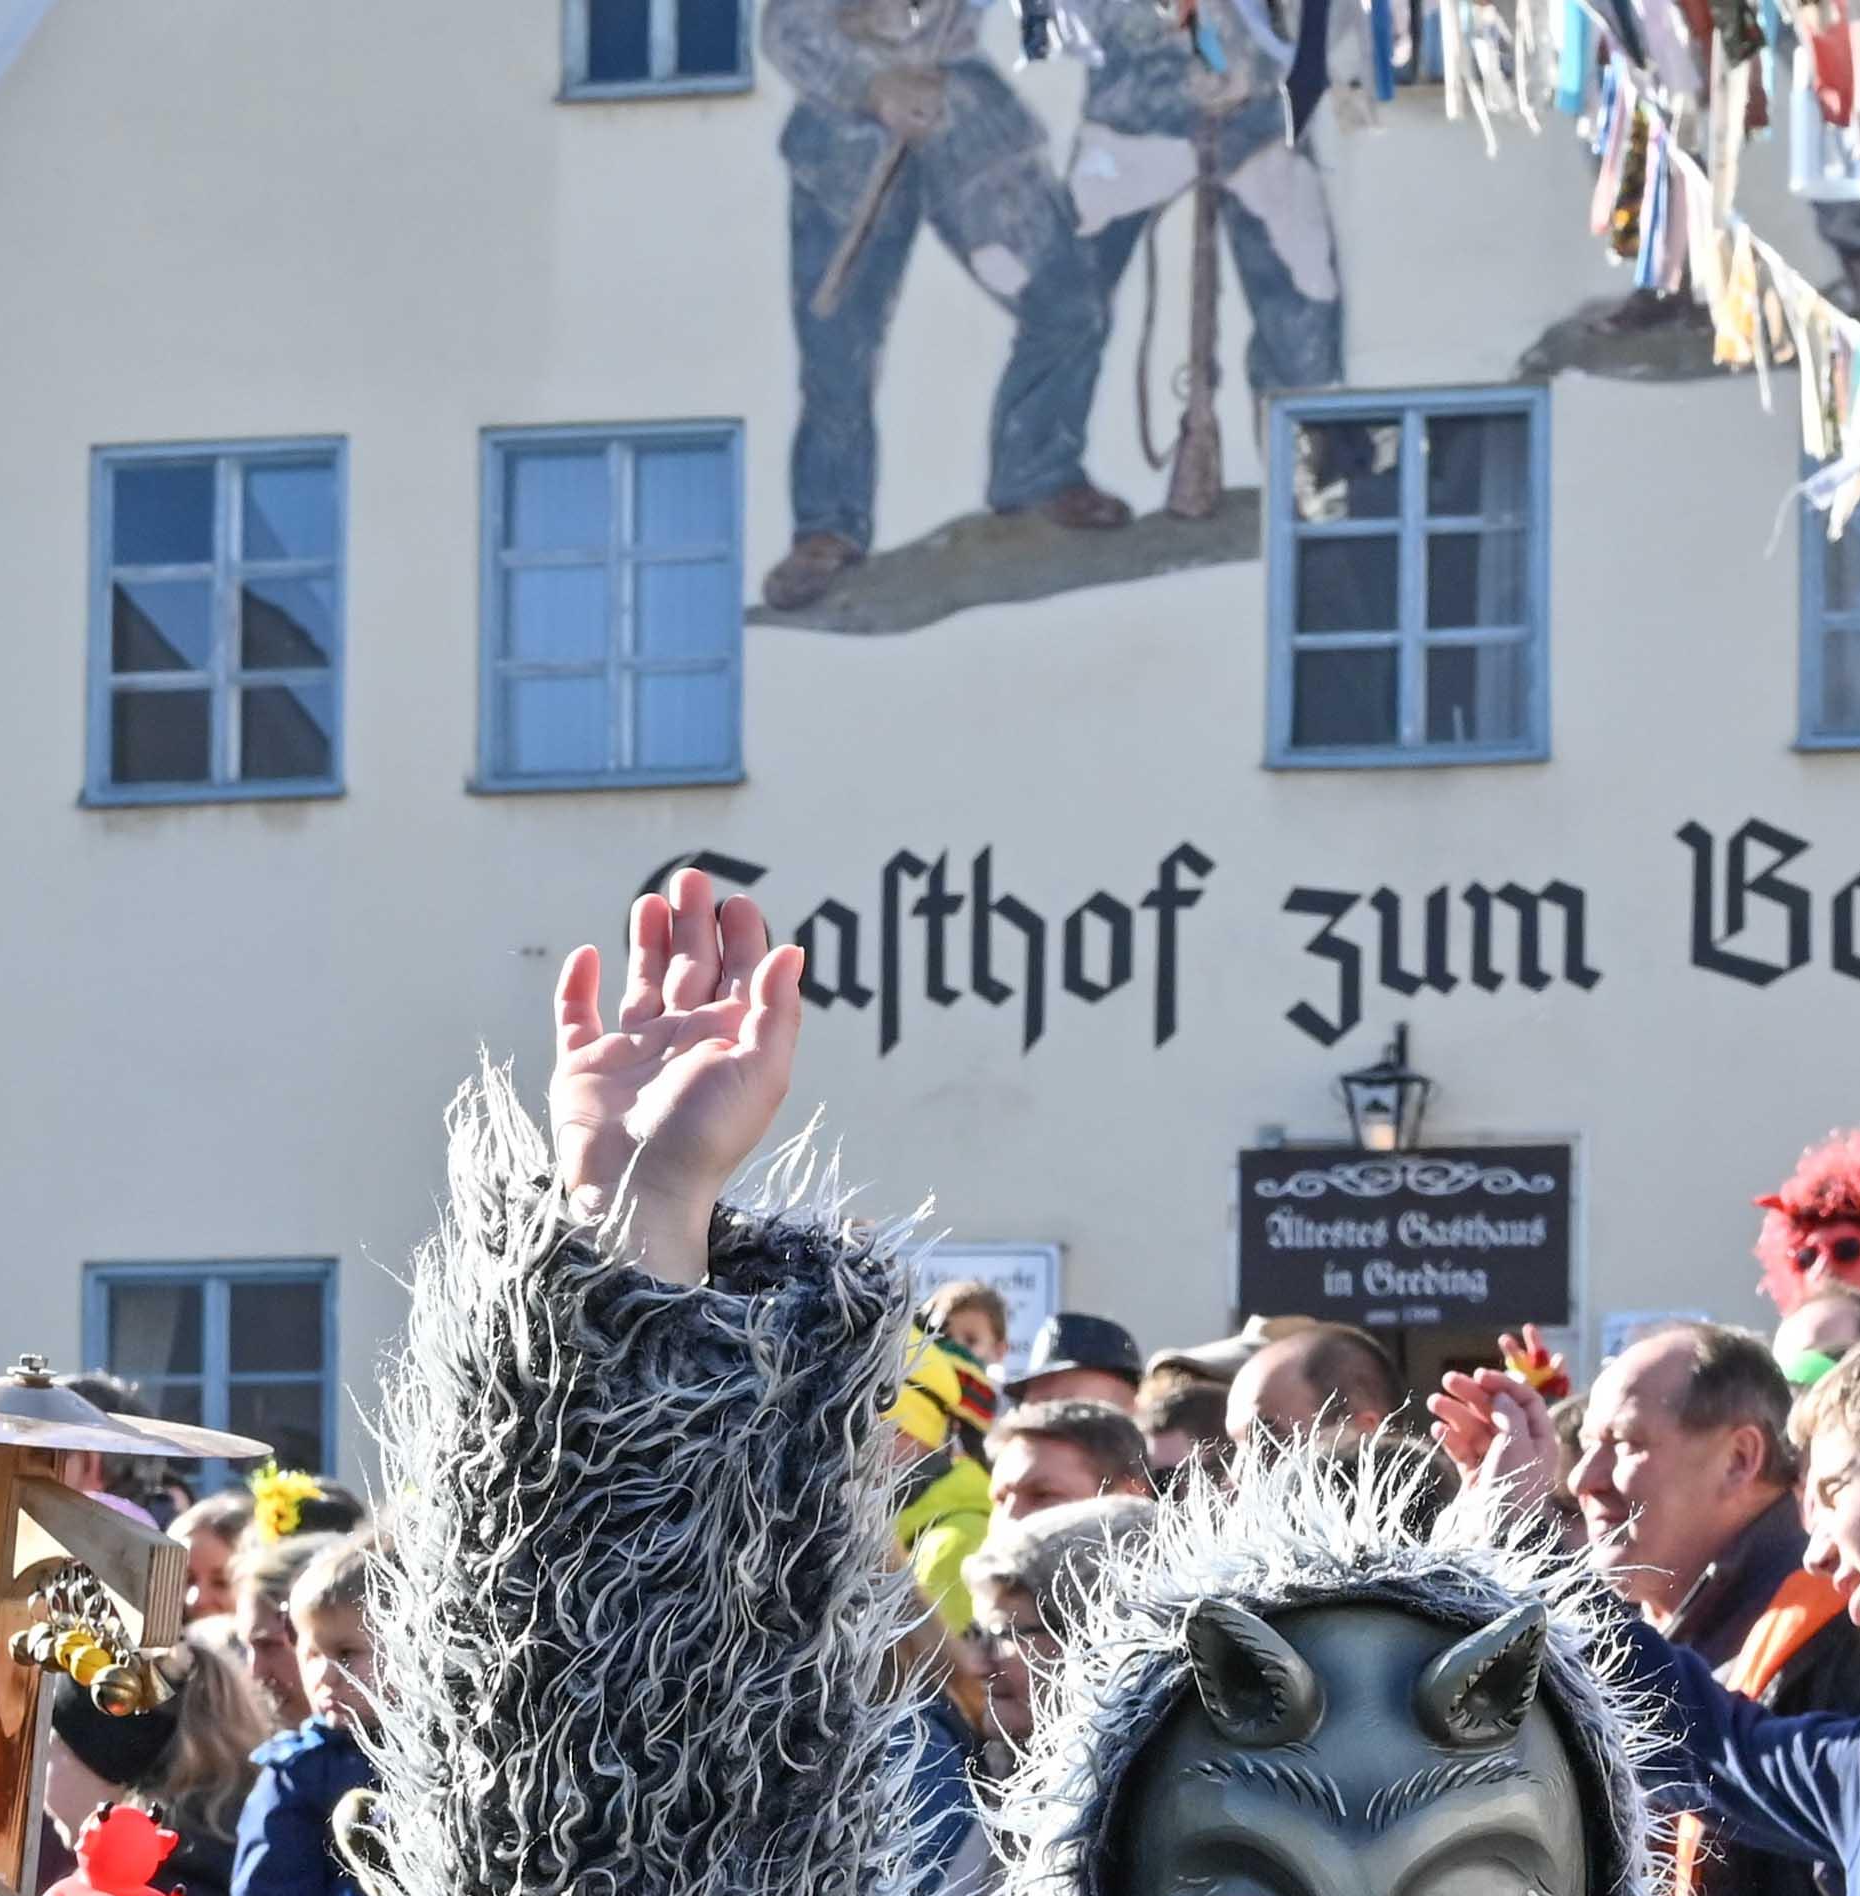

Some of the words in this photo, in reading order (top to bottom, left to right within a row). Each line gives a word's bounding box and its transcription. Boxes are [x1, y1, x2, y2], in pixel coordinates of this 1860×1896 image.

[1282, 878, 1604, 1047] zum
[1397, 1210, 1548, 1251] Gasthaus
[1323, 1260, 1353, 1297] in
[1362, 1259, 1489, 1303] Greding
